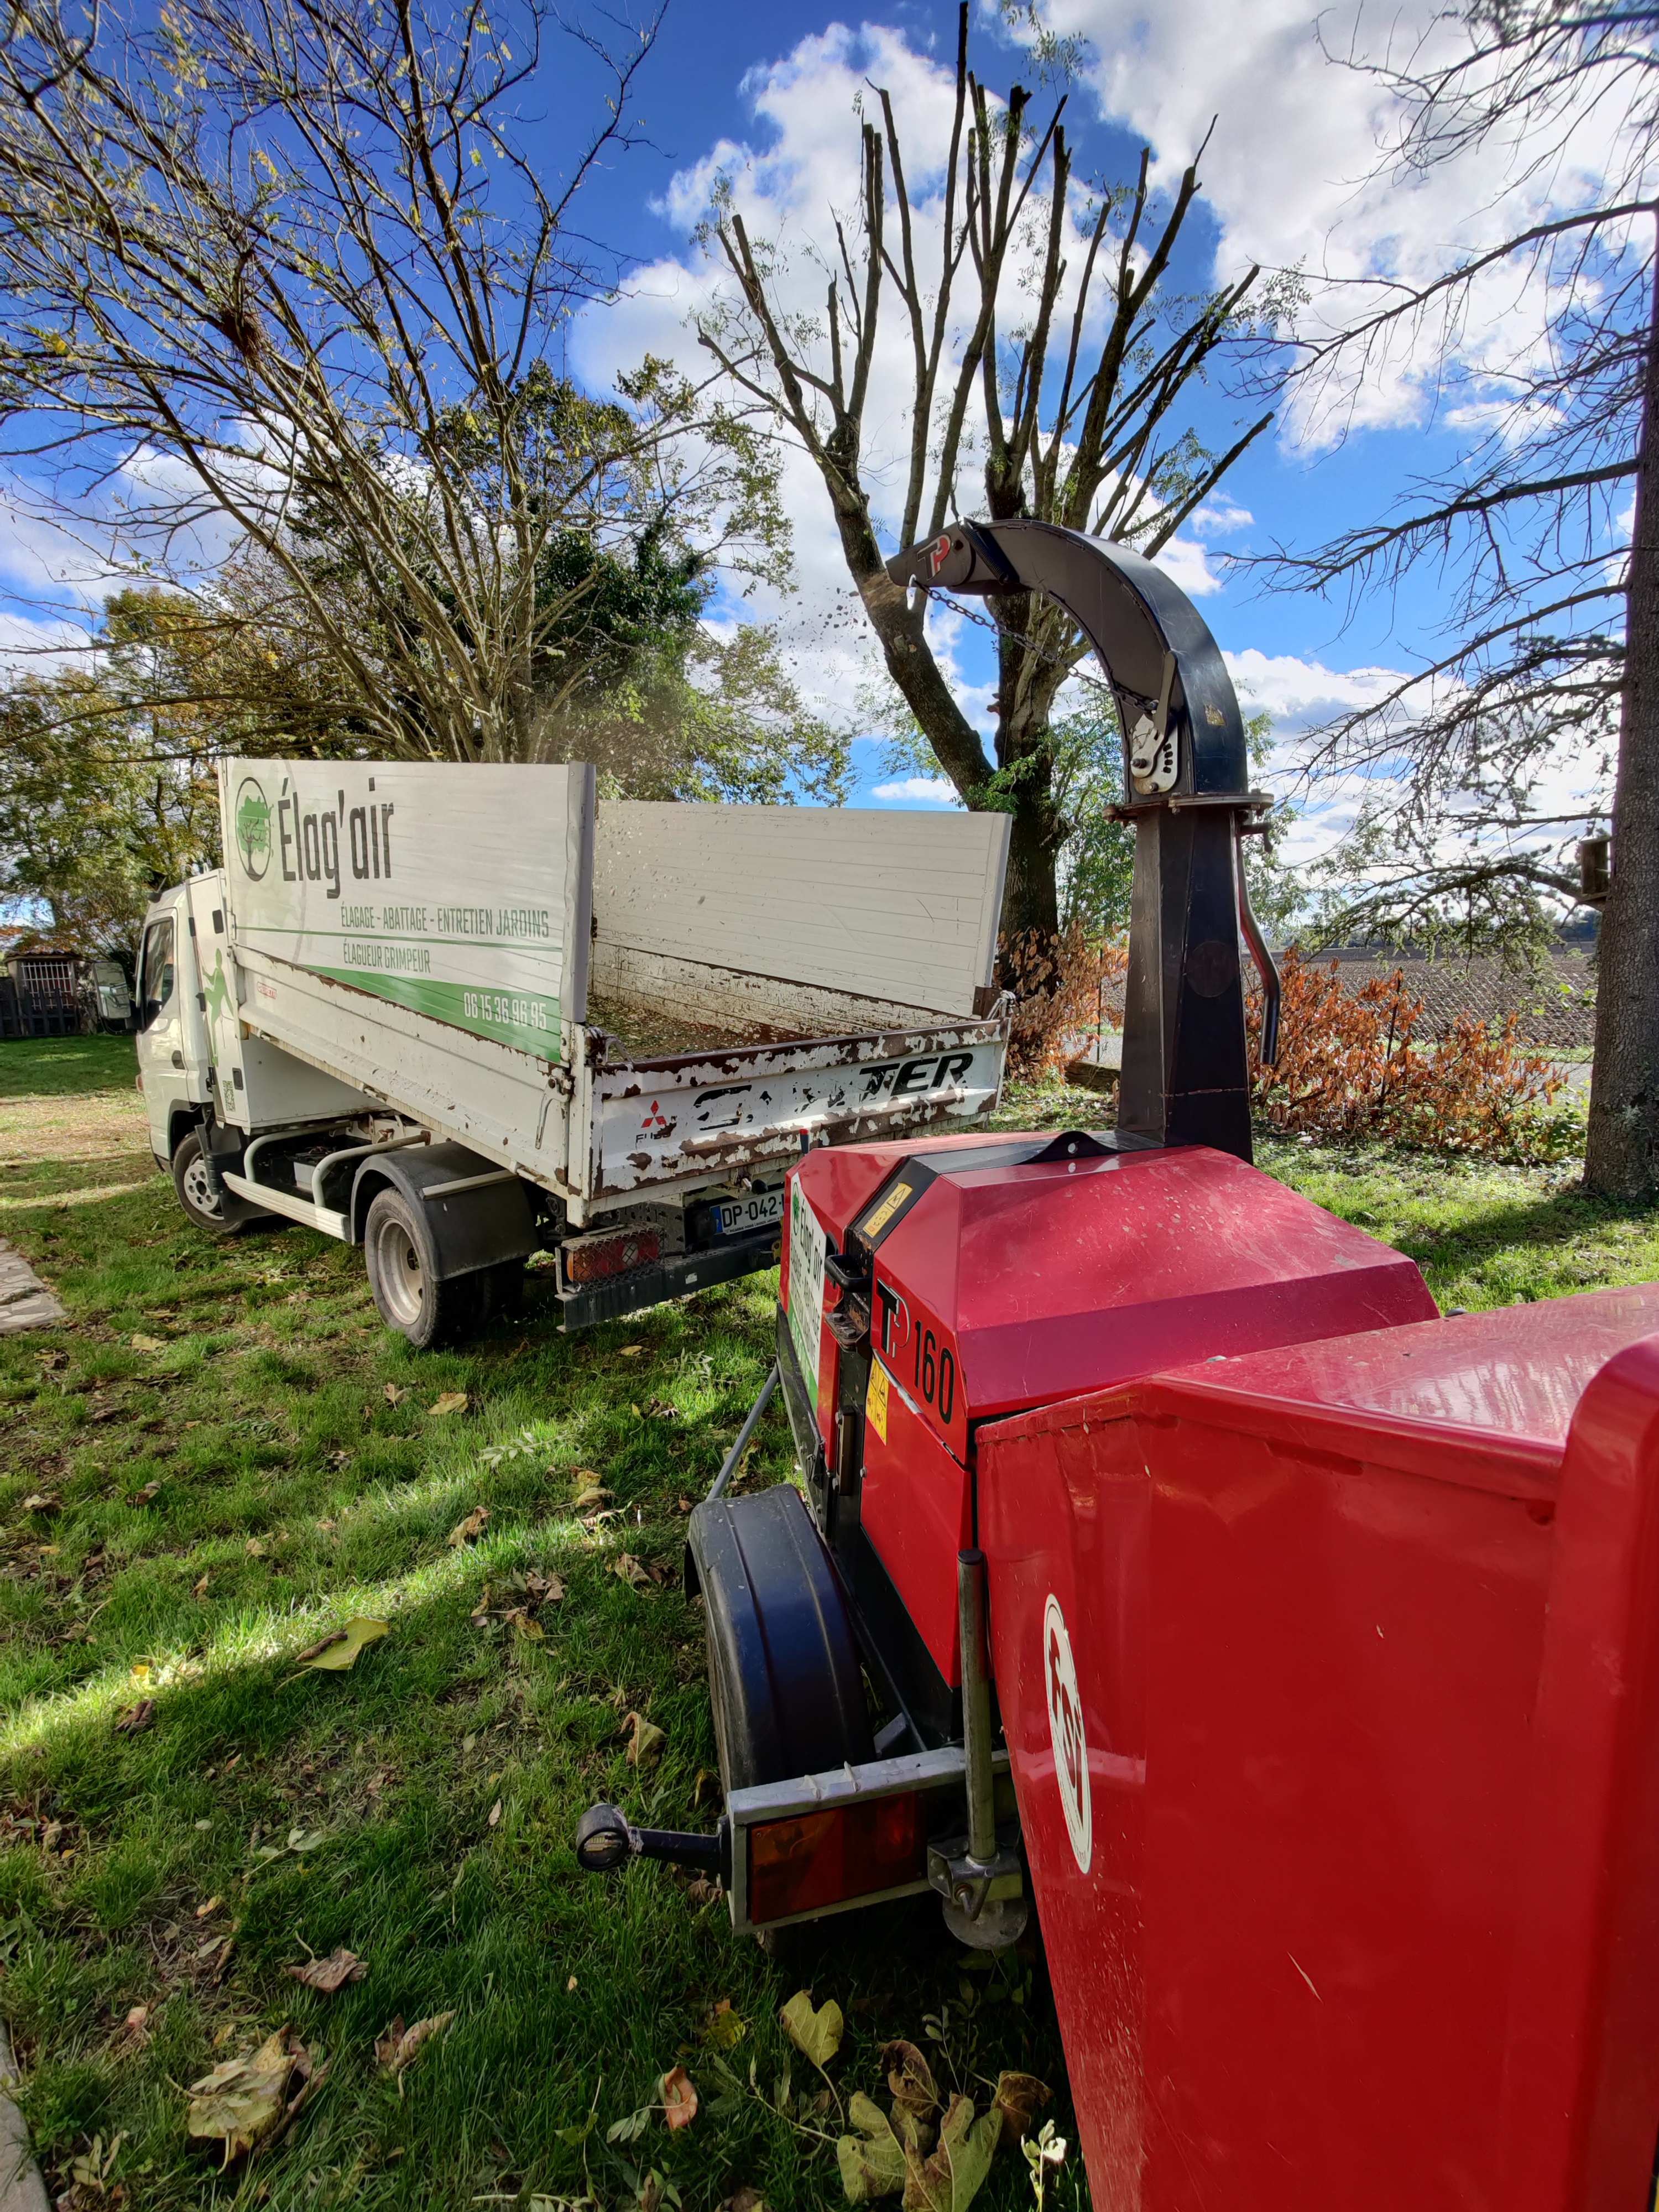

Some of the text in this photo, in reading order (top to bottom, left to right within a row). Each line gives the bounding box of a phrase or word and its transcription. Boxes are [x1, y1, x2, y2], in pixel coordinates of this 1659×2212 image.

[916, 534, 951, 581] TP
[278, 777, 394, 899] Élag'air
[341, 901, 375, 928] ÉLAGAGE
[383, 907, 427, 931] ABATTAGE
[437, 908, 492, 935] ENTRETIEN
[496, 910, 549, 938] JARDINS
[343, 938, 431, 973] ÉLAGUEUR GRIMPEUR
[464, 992, 547, 1030] 06 15 36 96 95
[722, 1193, 785, 1228] DP-042-
[876, 1278, 954, 1425] TP 160
